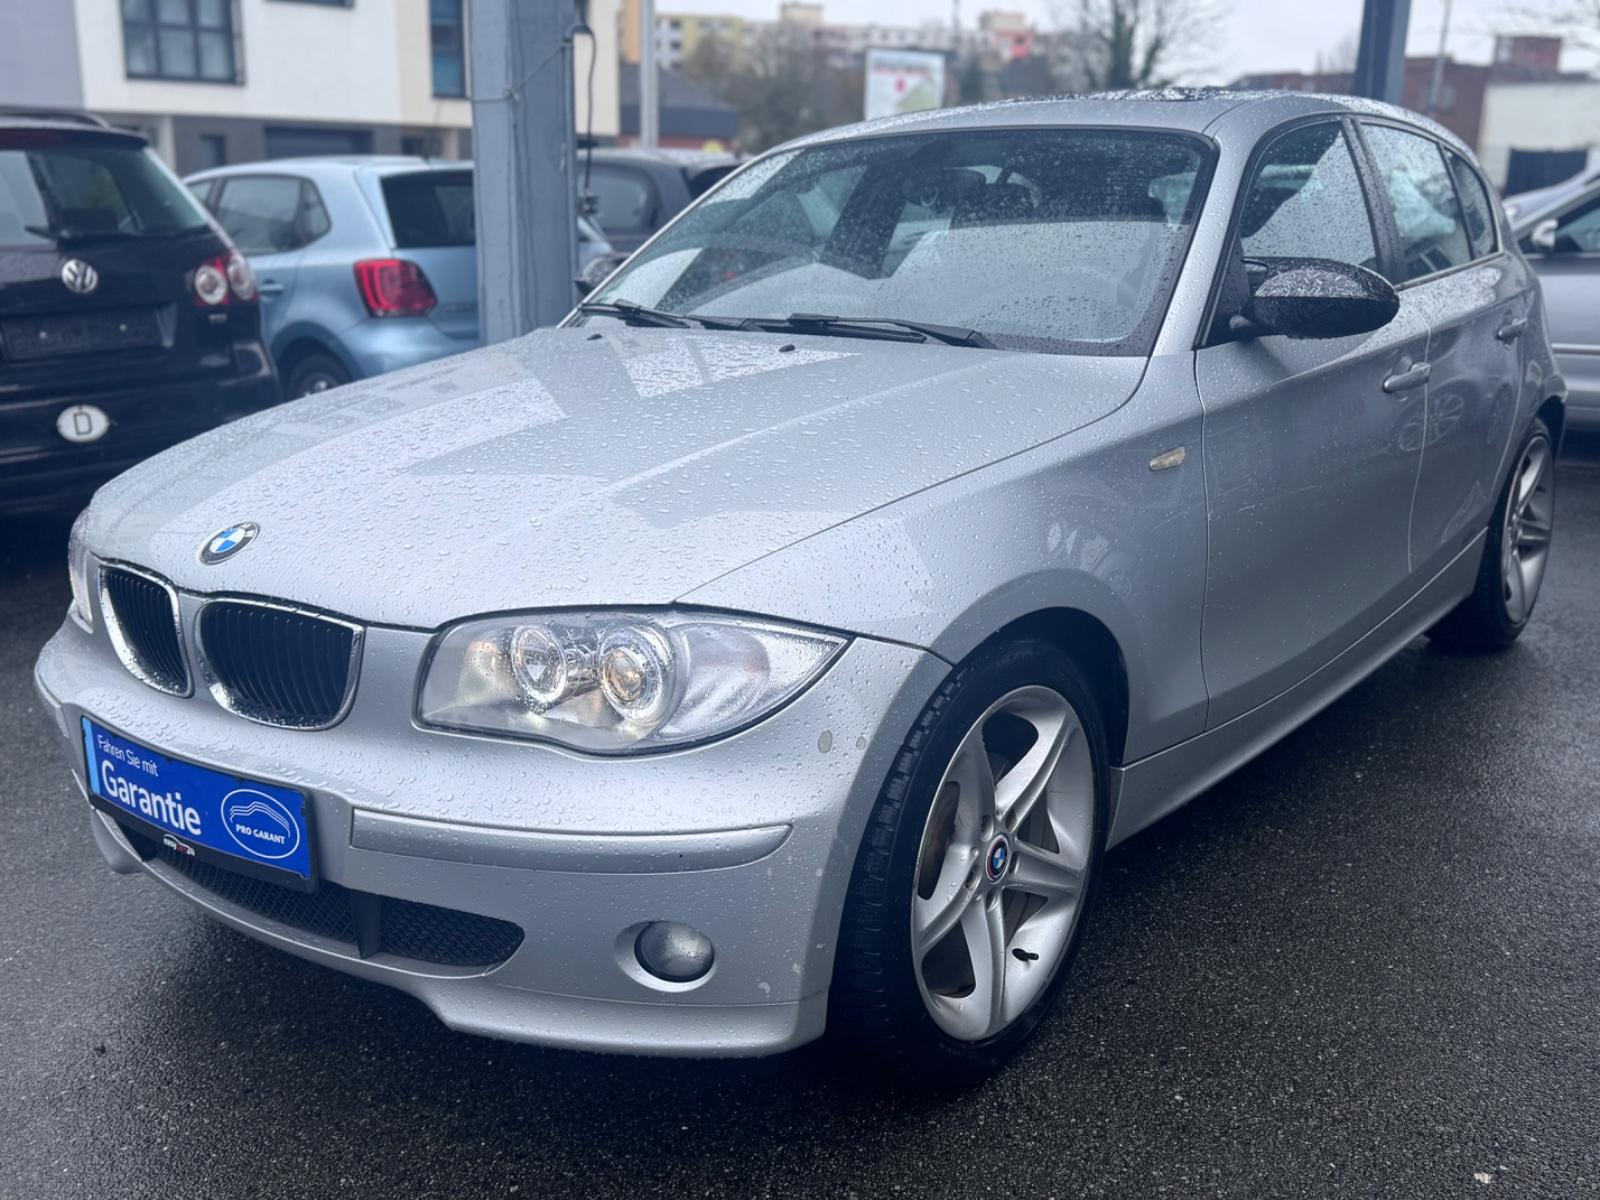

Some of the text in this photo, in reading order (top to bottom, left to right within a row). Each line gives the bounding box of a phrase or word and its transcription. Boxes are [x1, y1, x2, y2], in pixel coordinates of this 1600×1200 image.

[73, 411, 93, 436] D
[97, 734, 159, 777] Fahren Sie mit
[101, 759, 202, 835] Garantie
[235, 824, 285, 845] PRO GARANT
